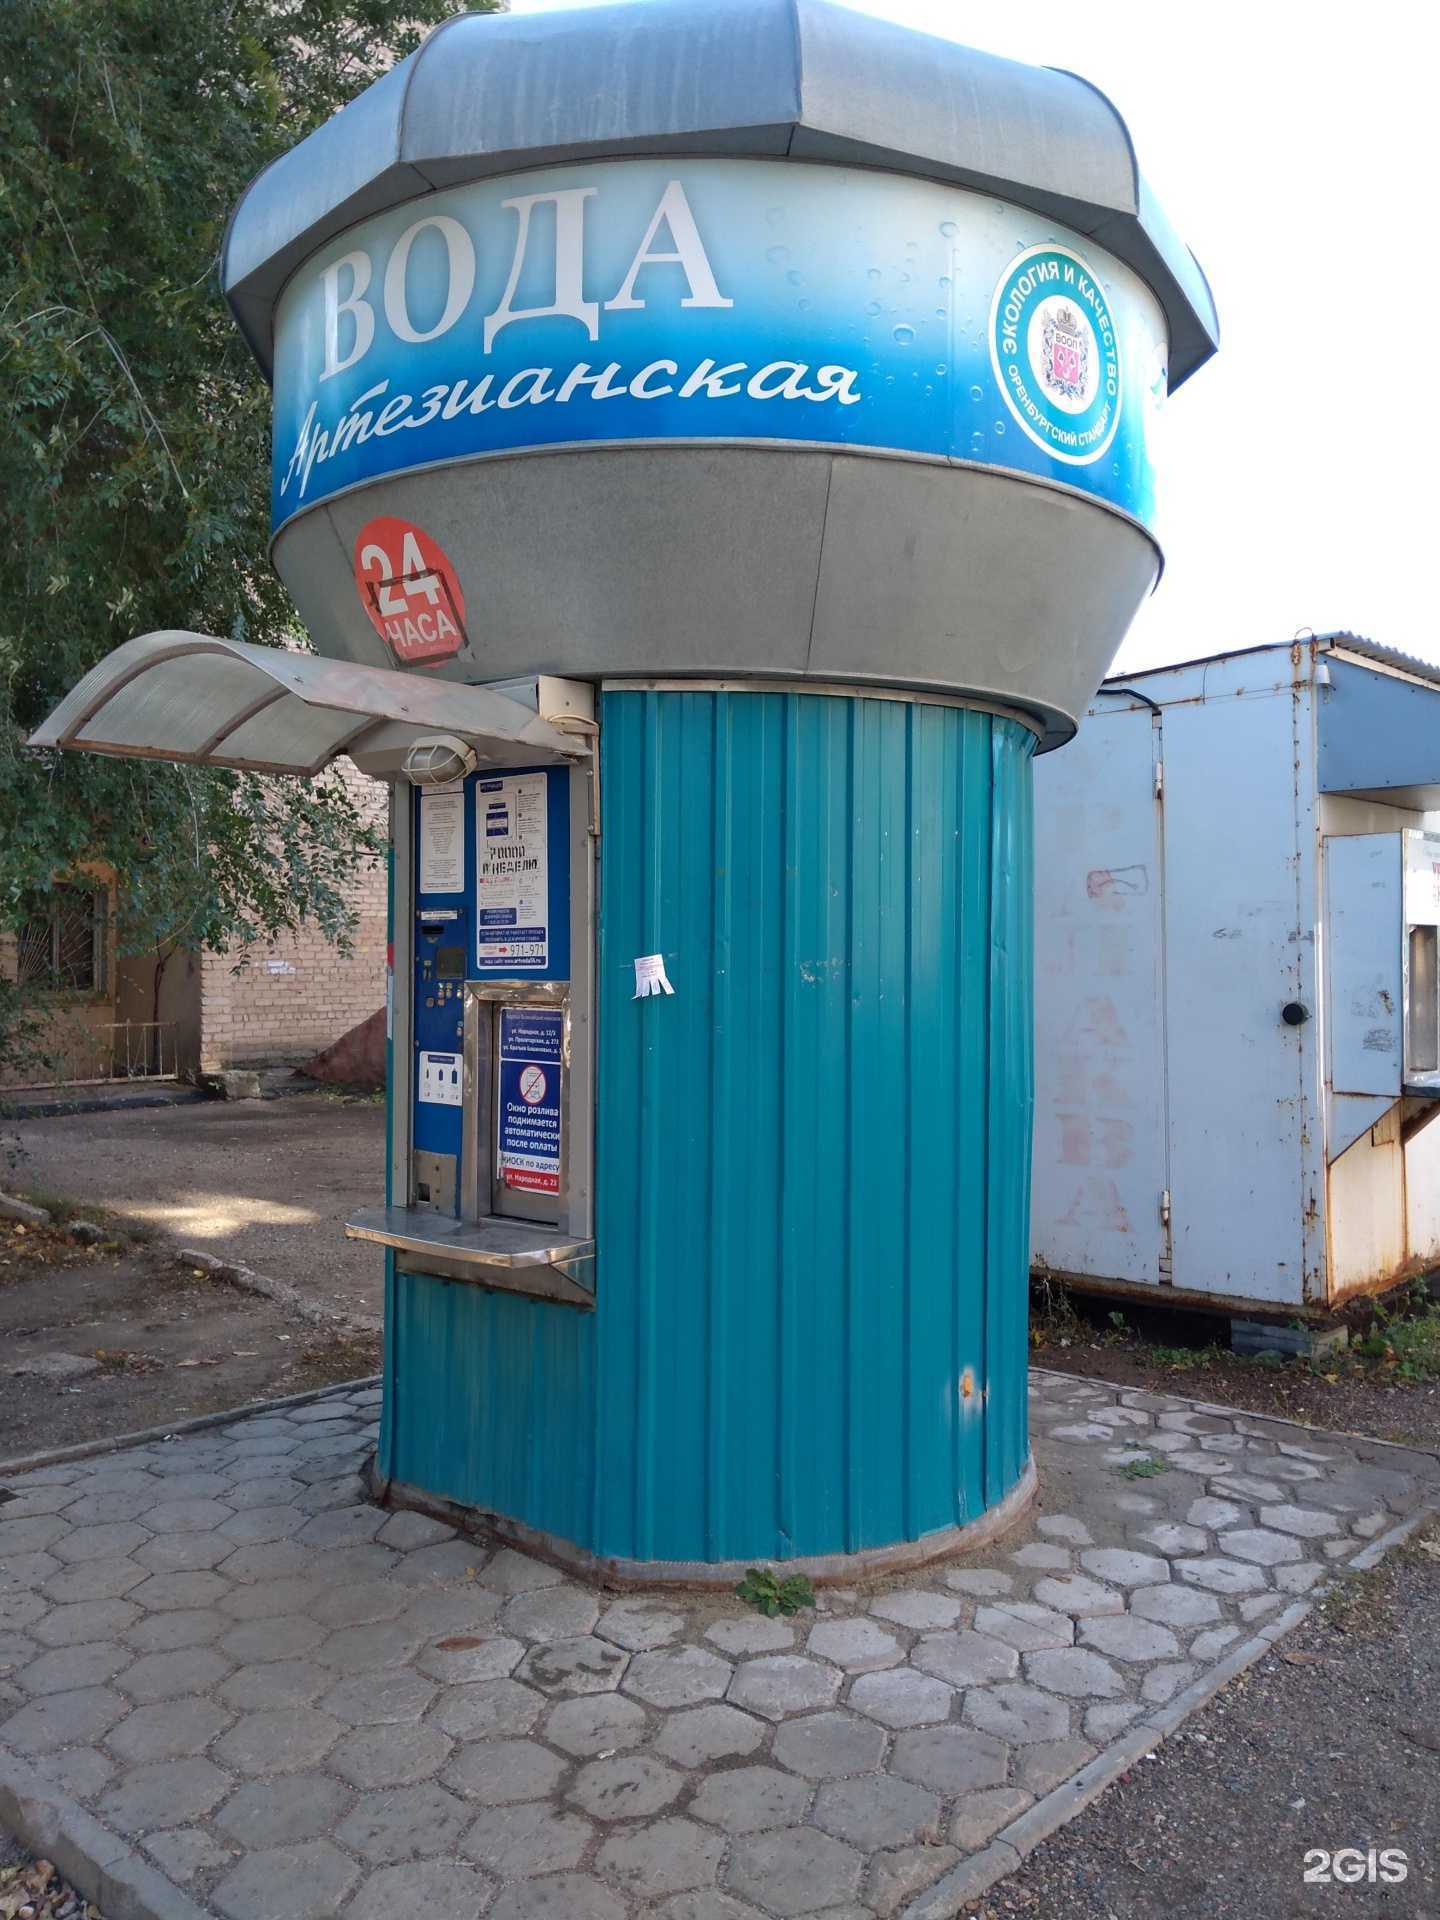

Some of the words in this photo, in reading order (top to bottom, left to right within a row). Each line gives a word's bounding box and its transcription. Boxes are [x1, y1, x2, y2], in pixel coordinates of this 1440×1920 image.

[319, 180, 734, 383] ВОДА
[1002, 261, 1060, 355] ЭКОЛОГИЯ
[1064, 264, 1075, 284] И
[1077, 275, 1117, 396] КАЧЕСТВО
[1055, 333, 1079, 350] ВООП
[1008, 364, 1078, 448] ОРЕНБУРГСКИЙ
[1077, 400, 1113, 447] СТАНДАРТ
[280, 358, 861, 498] Артезианская
[360, 532, 441, 617] 24
[385, 609, 457, 649] ЧАСА
[492, 858, 538, 875] НЕДЕЛЮ
[510, 944, 544, 956] 971-971
[507, 1102, 527, 1113] Окно
[527, 1106, 559, 1117] розлива
[508, 1116, 557, 1128] поднимается
[507, 1139, 528, 1149] после
[529, 1141, 558, 1152] оплаты
[525, 1160, 534, 1168] по
